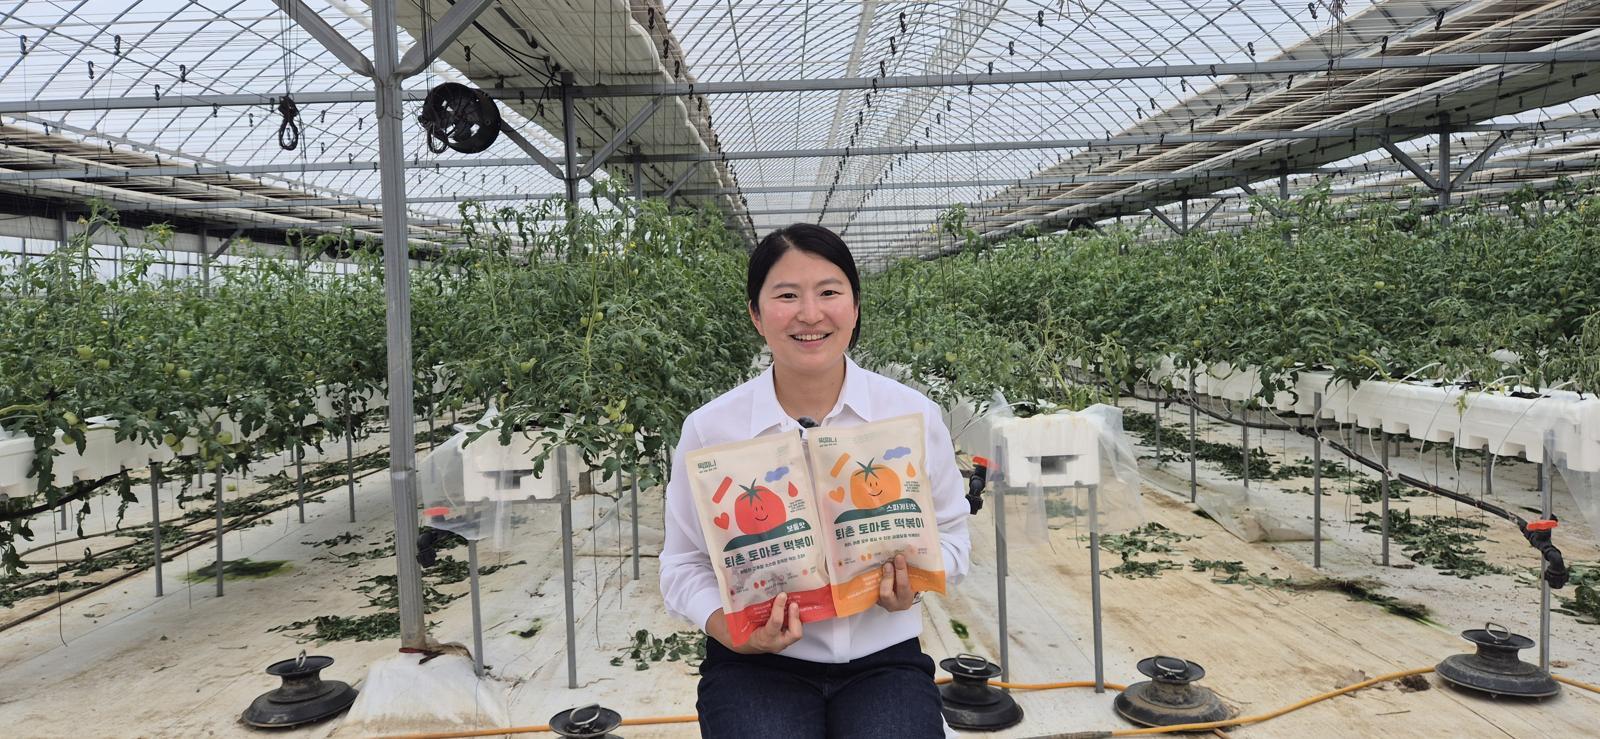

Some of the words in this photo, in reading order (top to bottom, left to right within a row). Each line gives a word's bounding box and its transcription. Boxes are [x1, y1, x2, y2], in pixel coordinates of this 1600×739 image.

[886, 502, 917, 512] 스파게티맛
[835, 525, 855, 540] 퇴촌
[858, 519, 892, 535] 토마토
[894, 517, 925, 529] 떡볶이
[724, 552, 746, 569] 퇴촌
[748, 543, 782, 562] 토마토
[783, 535, 814, 551] 떡볶이
